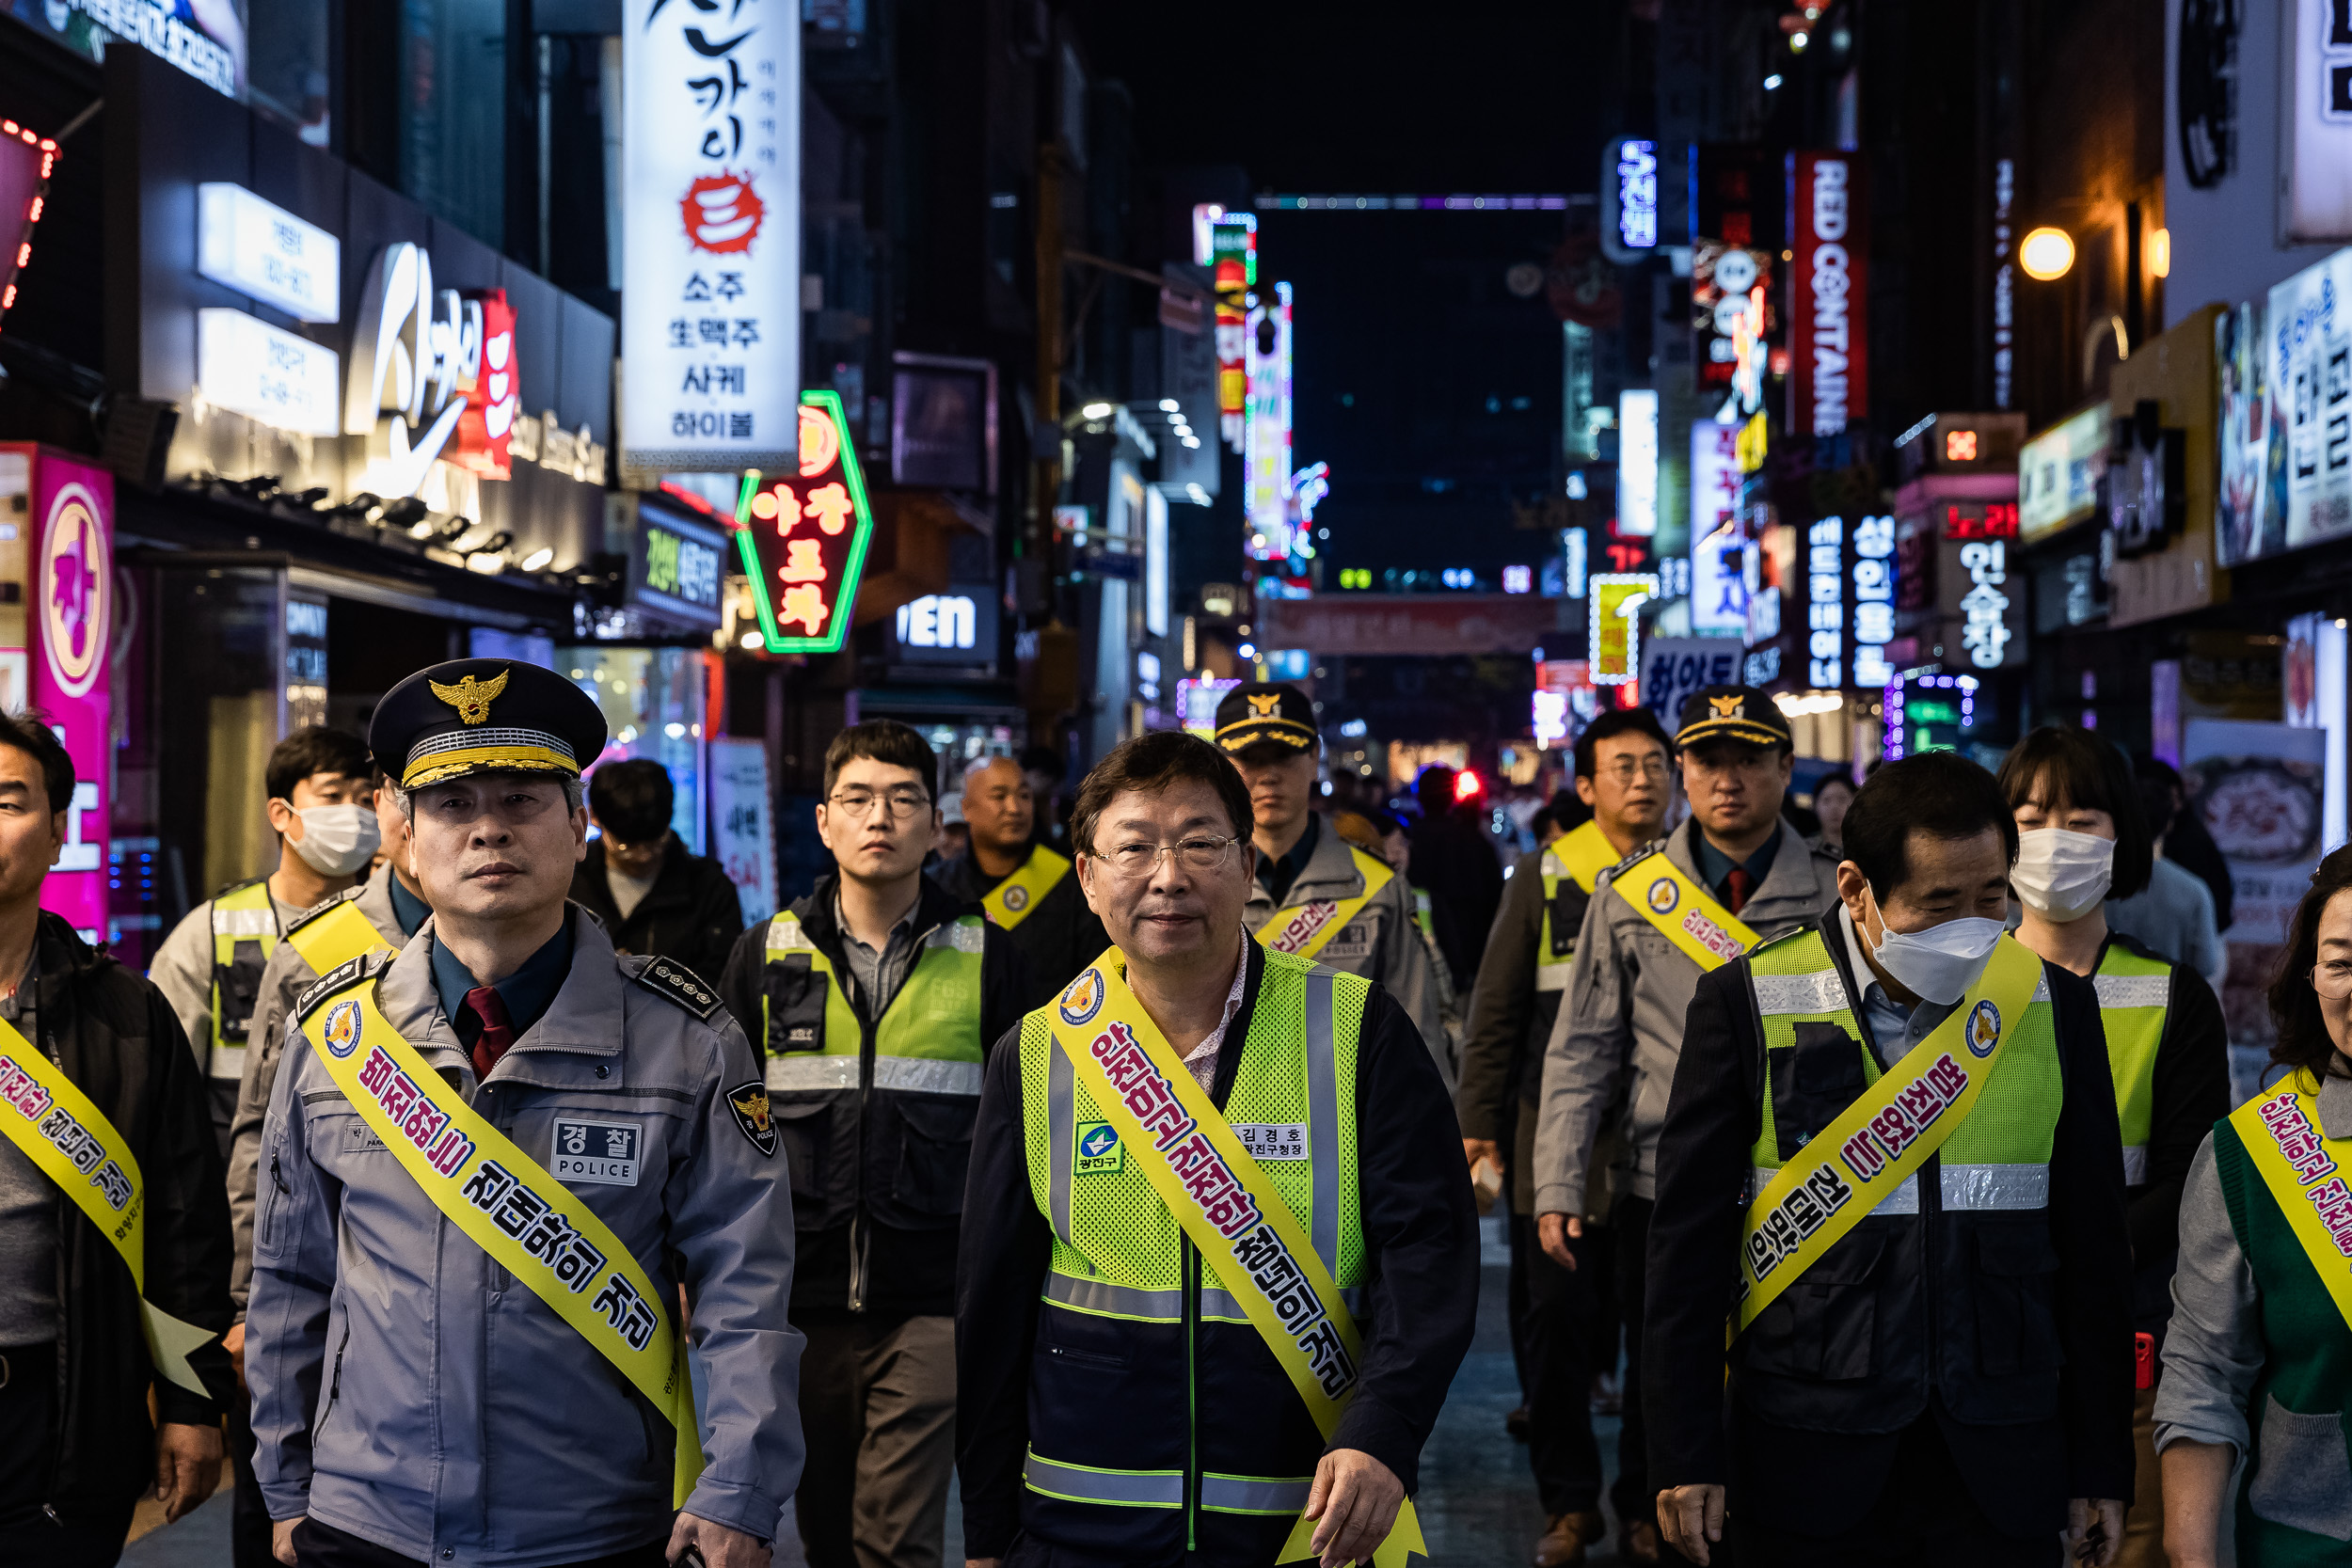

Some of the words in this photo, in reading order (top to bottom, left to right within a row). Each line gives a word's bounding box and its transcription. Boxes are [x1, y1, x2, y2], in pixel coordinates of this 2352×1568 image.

[1813, 158, 1850, 241] RED
[682, 270, 746, 303] 소주
[669, 318, 761, 349] 生맥주
[682, 365, 745, 395] 사케
[672, 411, 754, 438] 하이볼
[1852, 515, 1896, 688] 성인용품
[38, 1106, 106, 1175] 청년의
[89, 1160, 134, 1212] 거리
[756, 1130, 774, 1140] POLICE
[1840, 1052, 1969, 1183] 범죄없는
[2258, 1092, 2339, 1186] 안전하고
[357, 1044, 476, 1178] 범죄없는
[459, 1159, 609, 1294] 건대맛의
[590, 1272, 659, 1353] 거리
[559, 1160, 630, 1178] POLICE
[1079, 1157, 1117, 1169] 광진구
[1089, 1021, 1198, 1151] 안전하고
[1165, 1131, 1263, 1240] 건전한
[1231, 1223, 1327, 1337] 청년의
[1296, 1318, 1359, 1401] 거리
[1742, 1162, 1853, 1283] 건대맛의
